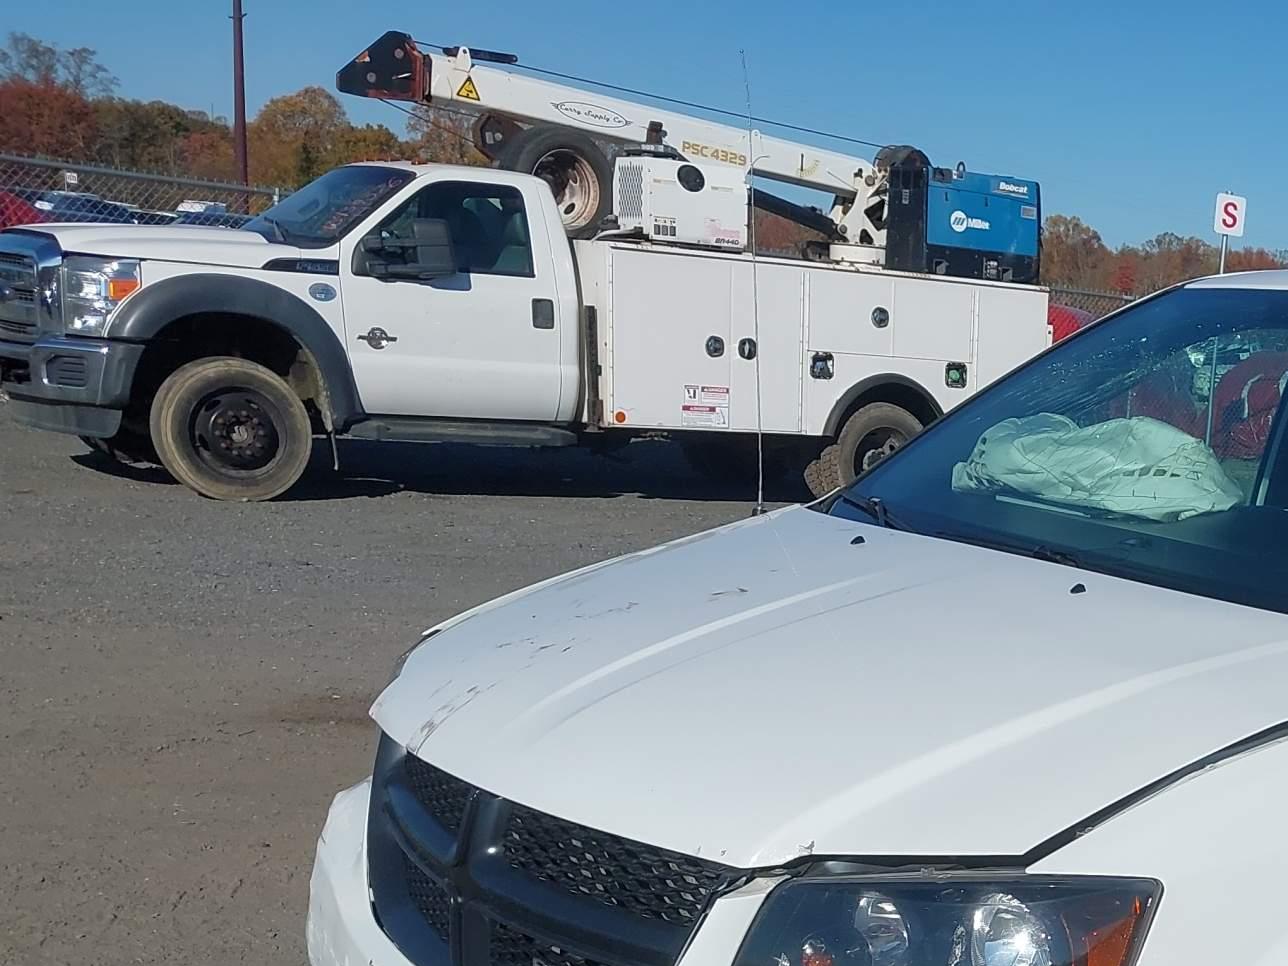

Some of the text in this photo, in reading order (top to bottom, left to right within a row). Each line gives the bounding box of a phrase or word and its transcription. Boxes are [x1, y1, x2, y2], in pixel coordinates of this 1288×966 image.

[682, 140, 747, 166] PSC 4329
[999, 182, 1028, 194] Bobcat
[967, 217, 991, 230] Miller
[1222, 202, 1238, 228] S
